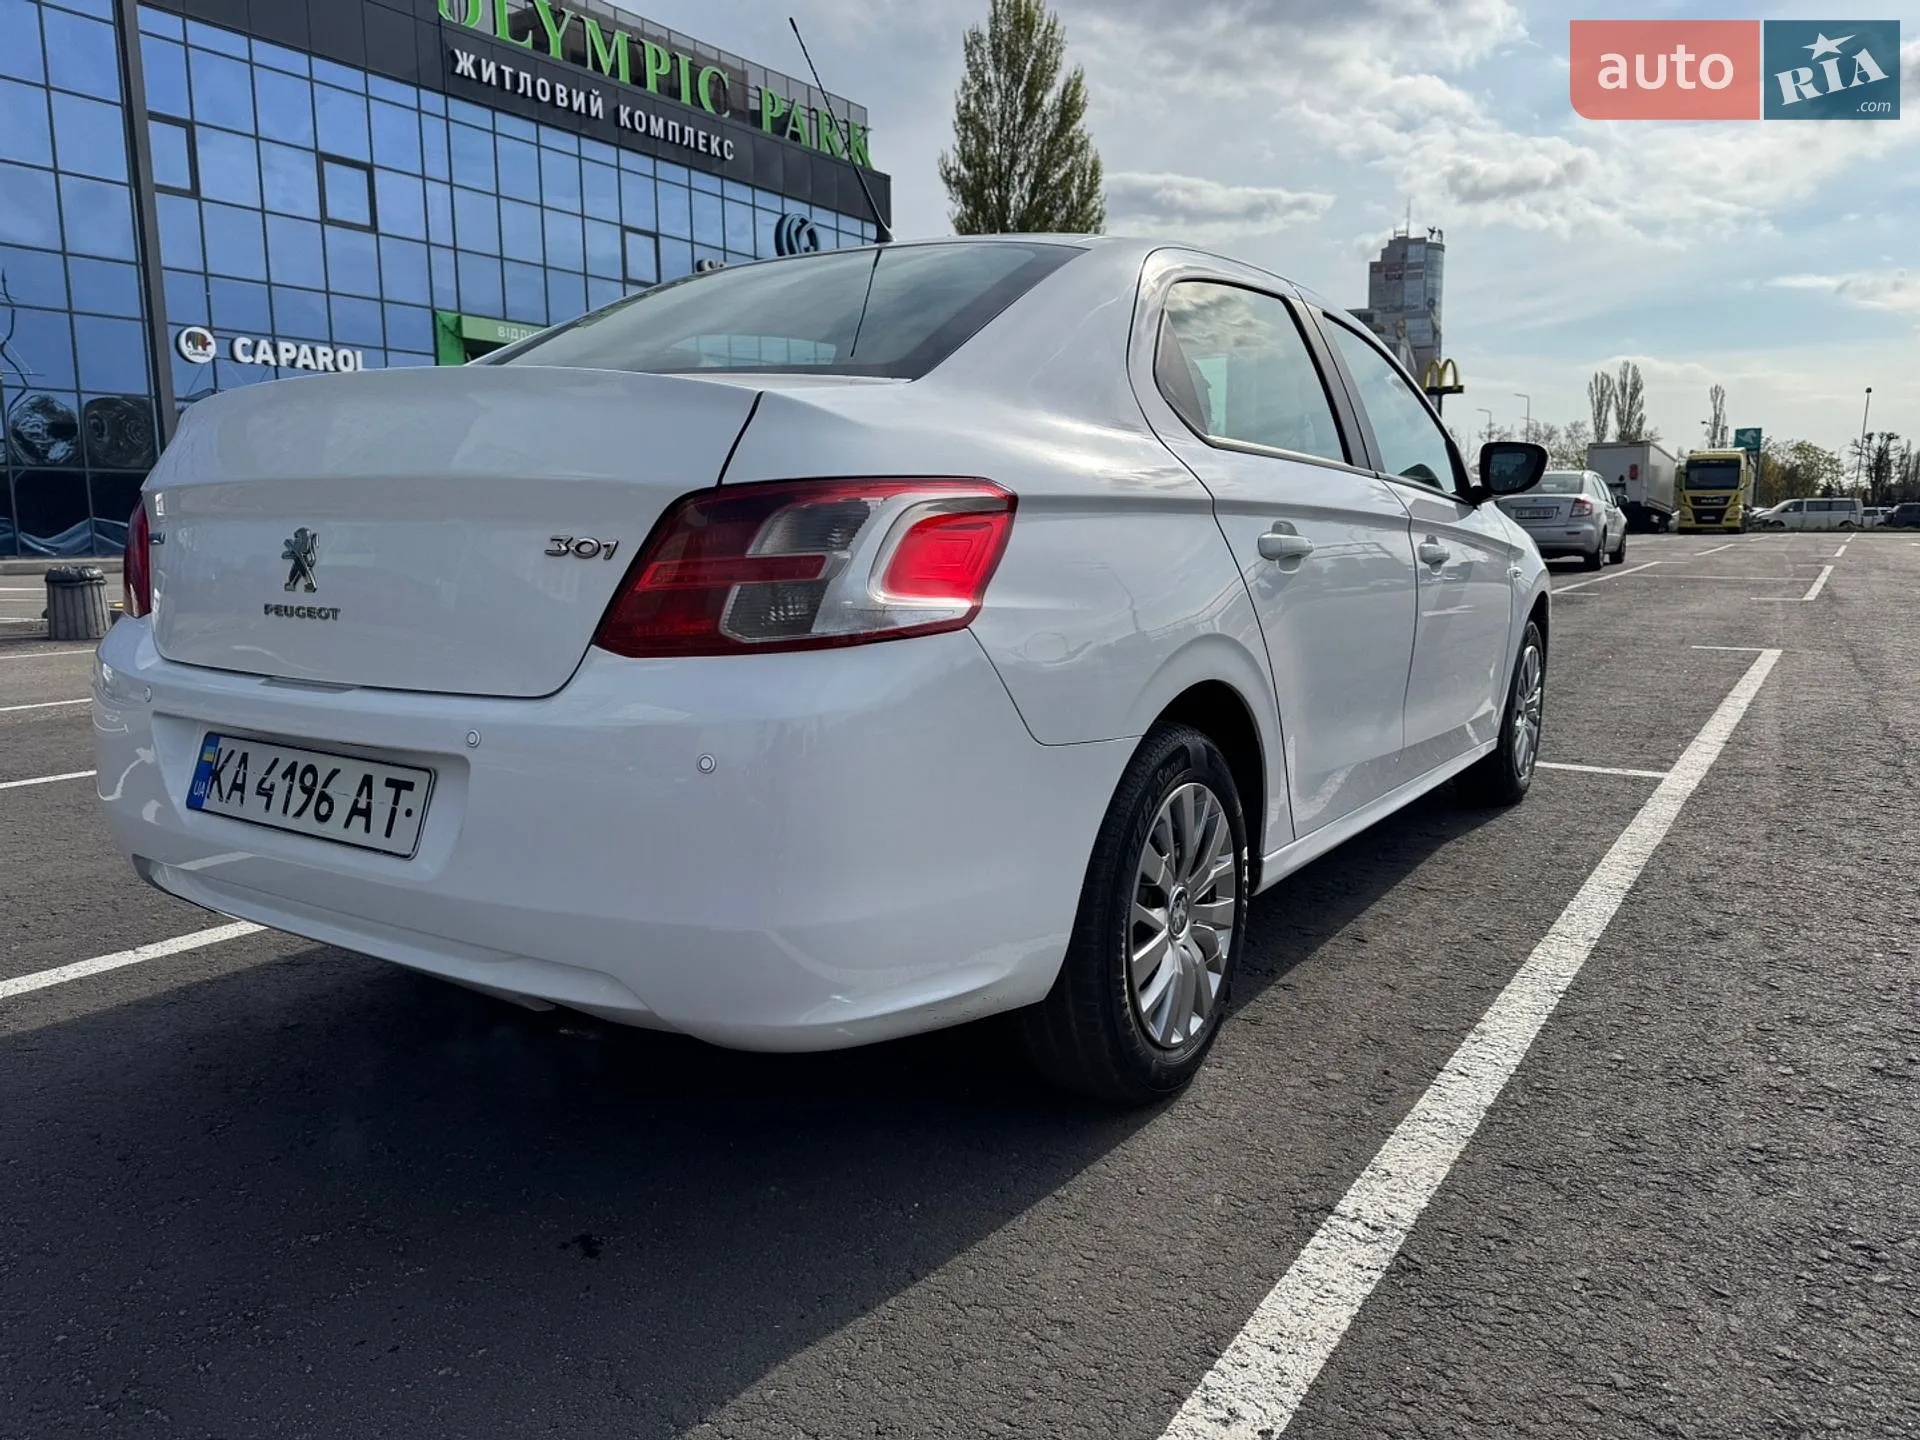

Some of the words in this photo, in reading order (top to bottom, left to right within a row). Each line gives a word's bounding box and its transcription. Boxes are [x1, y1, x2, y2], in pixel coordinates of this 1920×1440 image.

[453, 48, 603, 119] ЖИТЛОВИЙ
[618, 104, 734, 161] КОМПЛЕКС
[758, 86, 874, 170] PARK
[544, 534, 619, 560] 301
[264, 603, 340, 621] PEUGEOT
[207, 747, 249, 807] KA
[256, 757, 340, 823] 4196
[343, 773, 415, 839] AT
